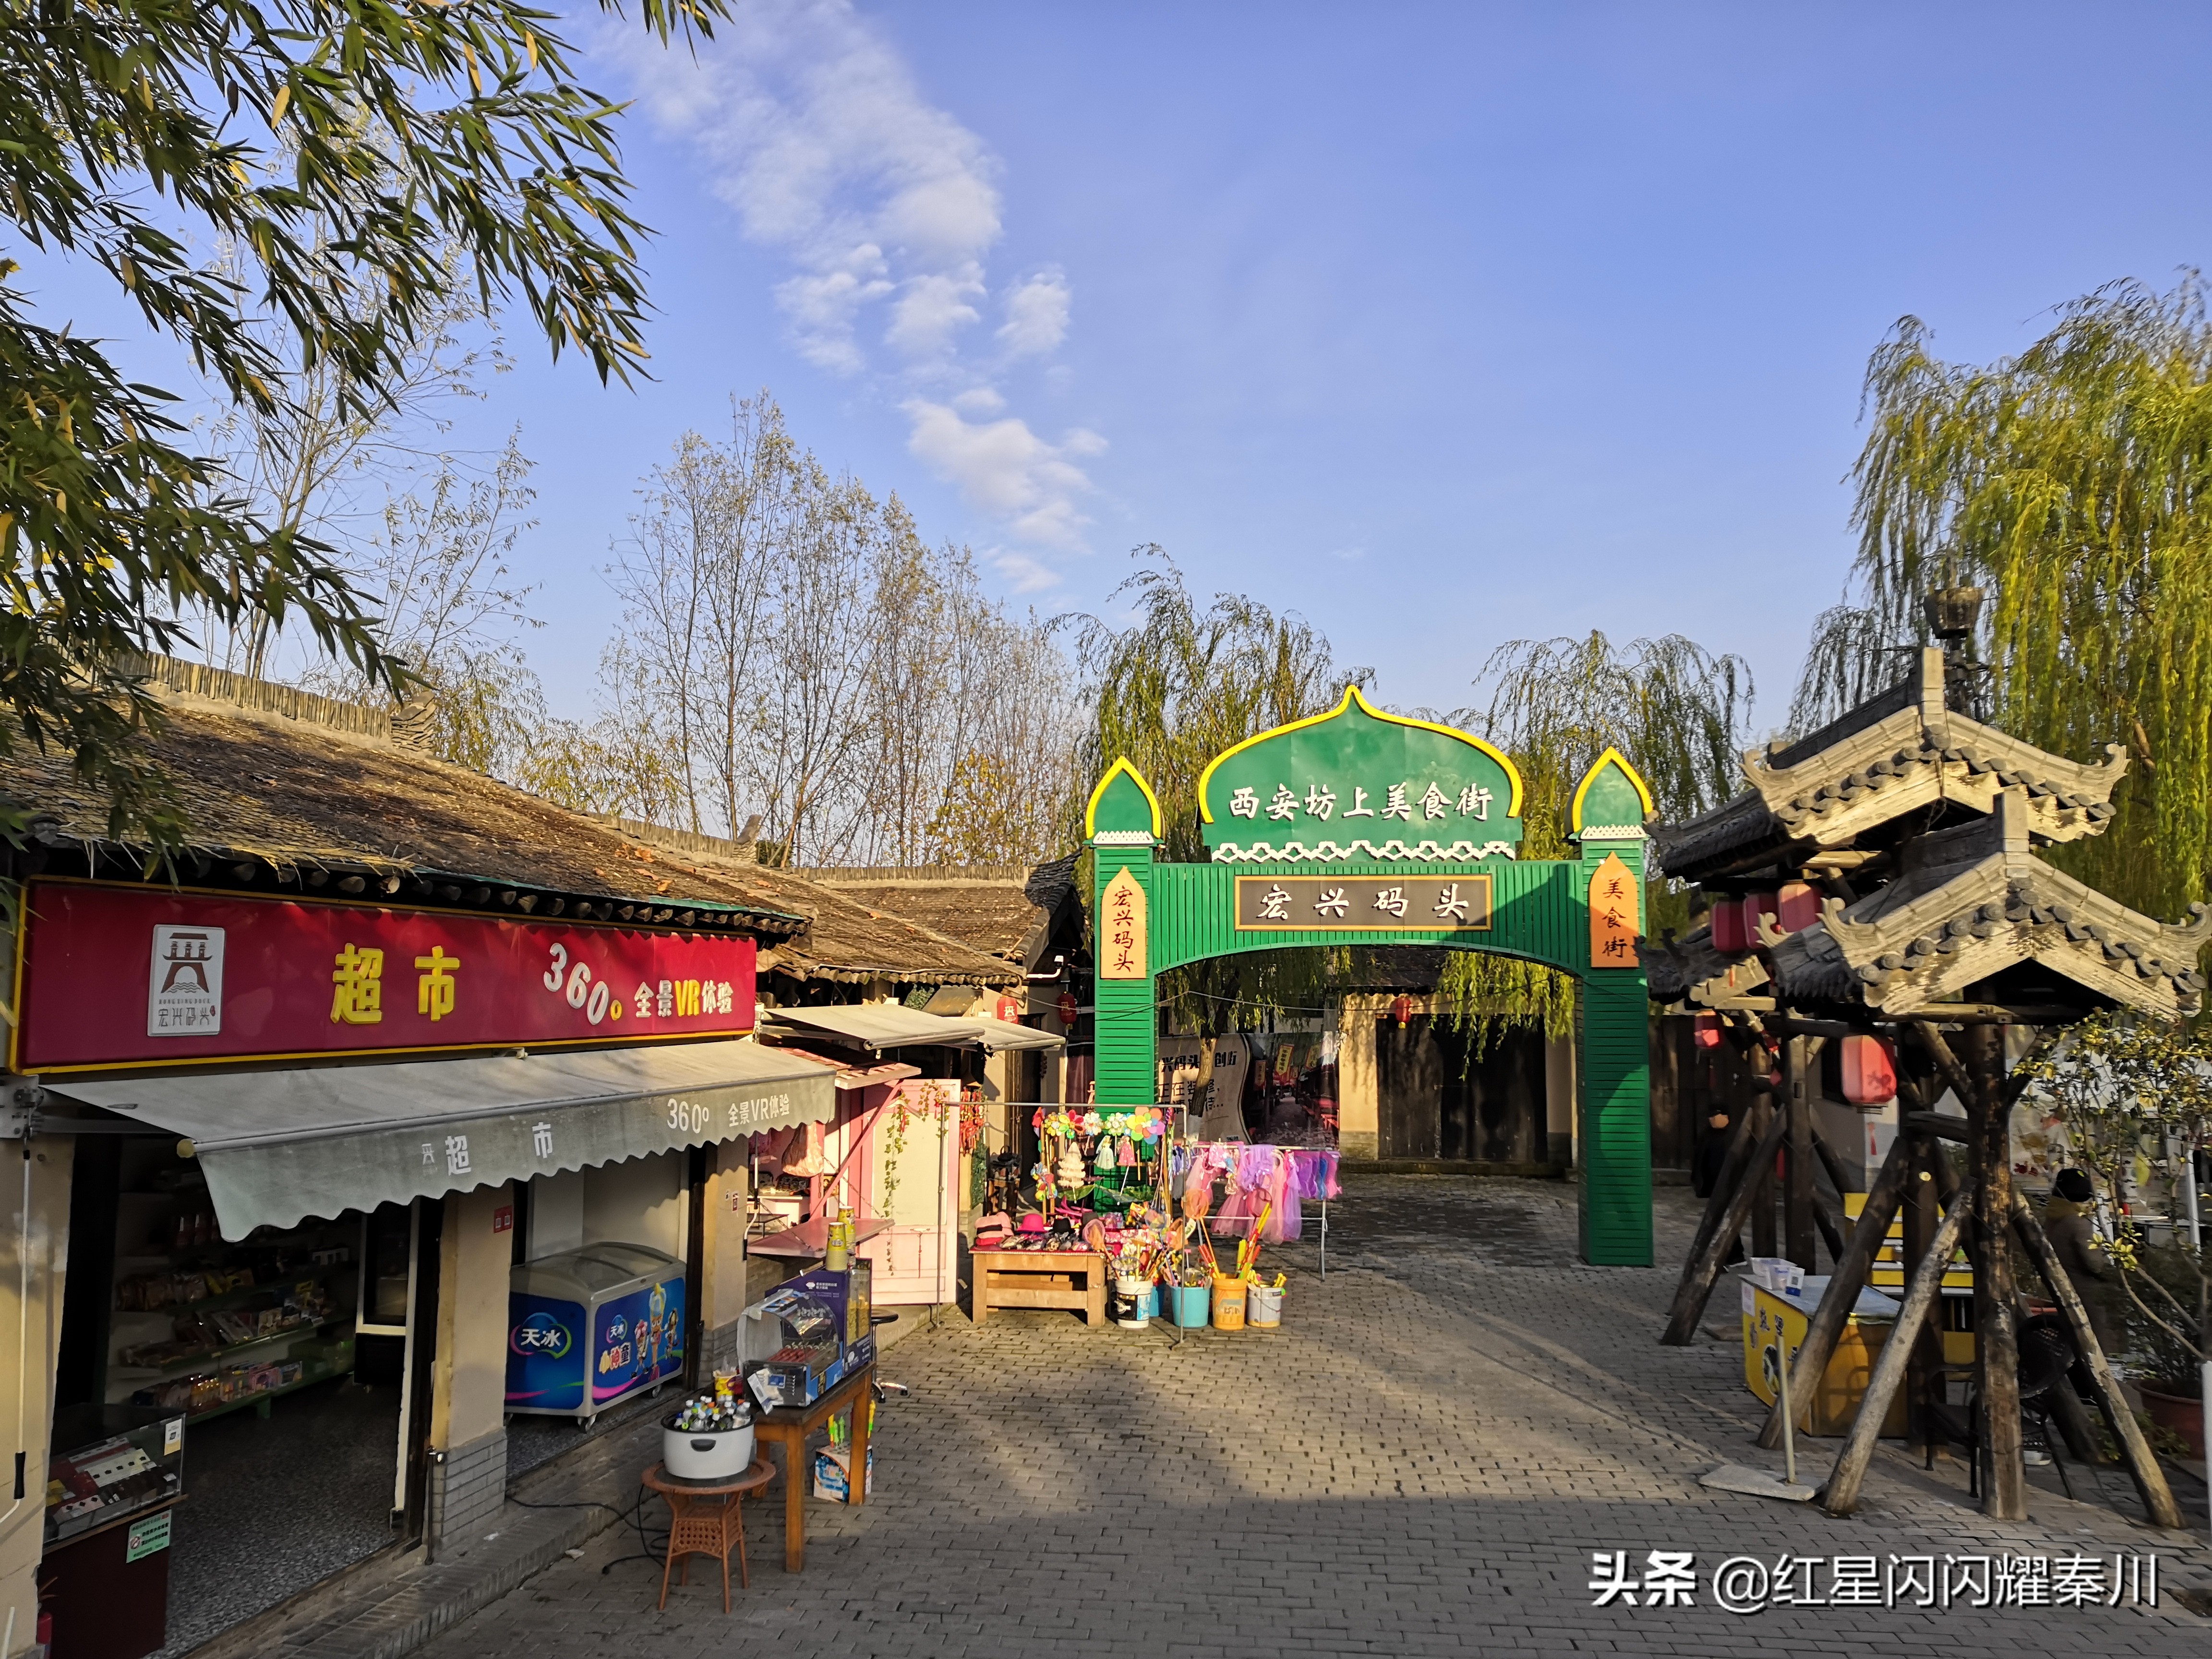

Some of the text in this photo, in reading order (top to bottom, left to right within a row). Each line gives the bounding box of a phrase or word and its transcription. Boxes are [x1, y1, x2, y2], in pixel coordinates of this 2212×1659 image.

[1229, 781, 1495, 823] 西安坊上美食街
[1257, 883, 1469, 920] 宏兴码头
[1601, 877, 1628, 959] 美食街
[1112, 885, 1134, 973] 宏兴码头
[332, 943, 460, 1024] 超市
[634, 978, 733, 1018] 全景VR体验
[728, 1093, 790, 1128] 全景VR体验
[521, 1328, 561, 1347] 天冰
